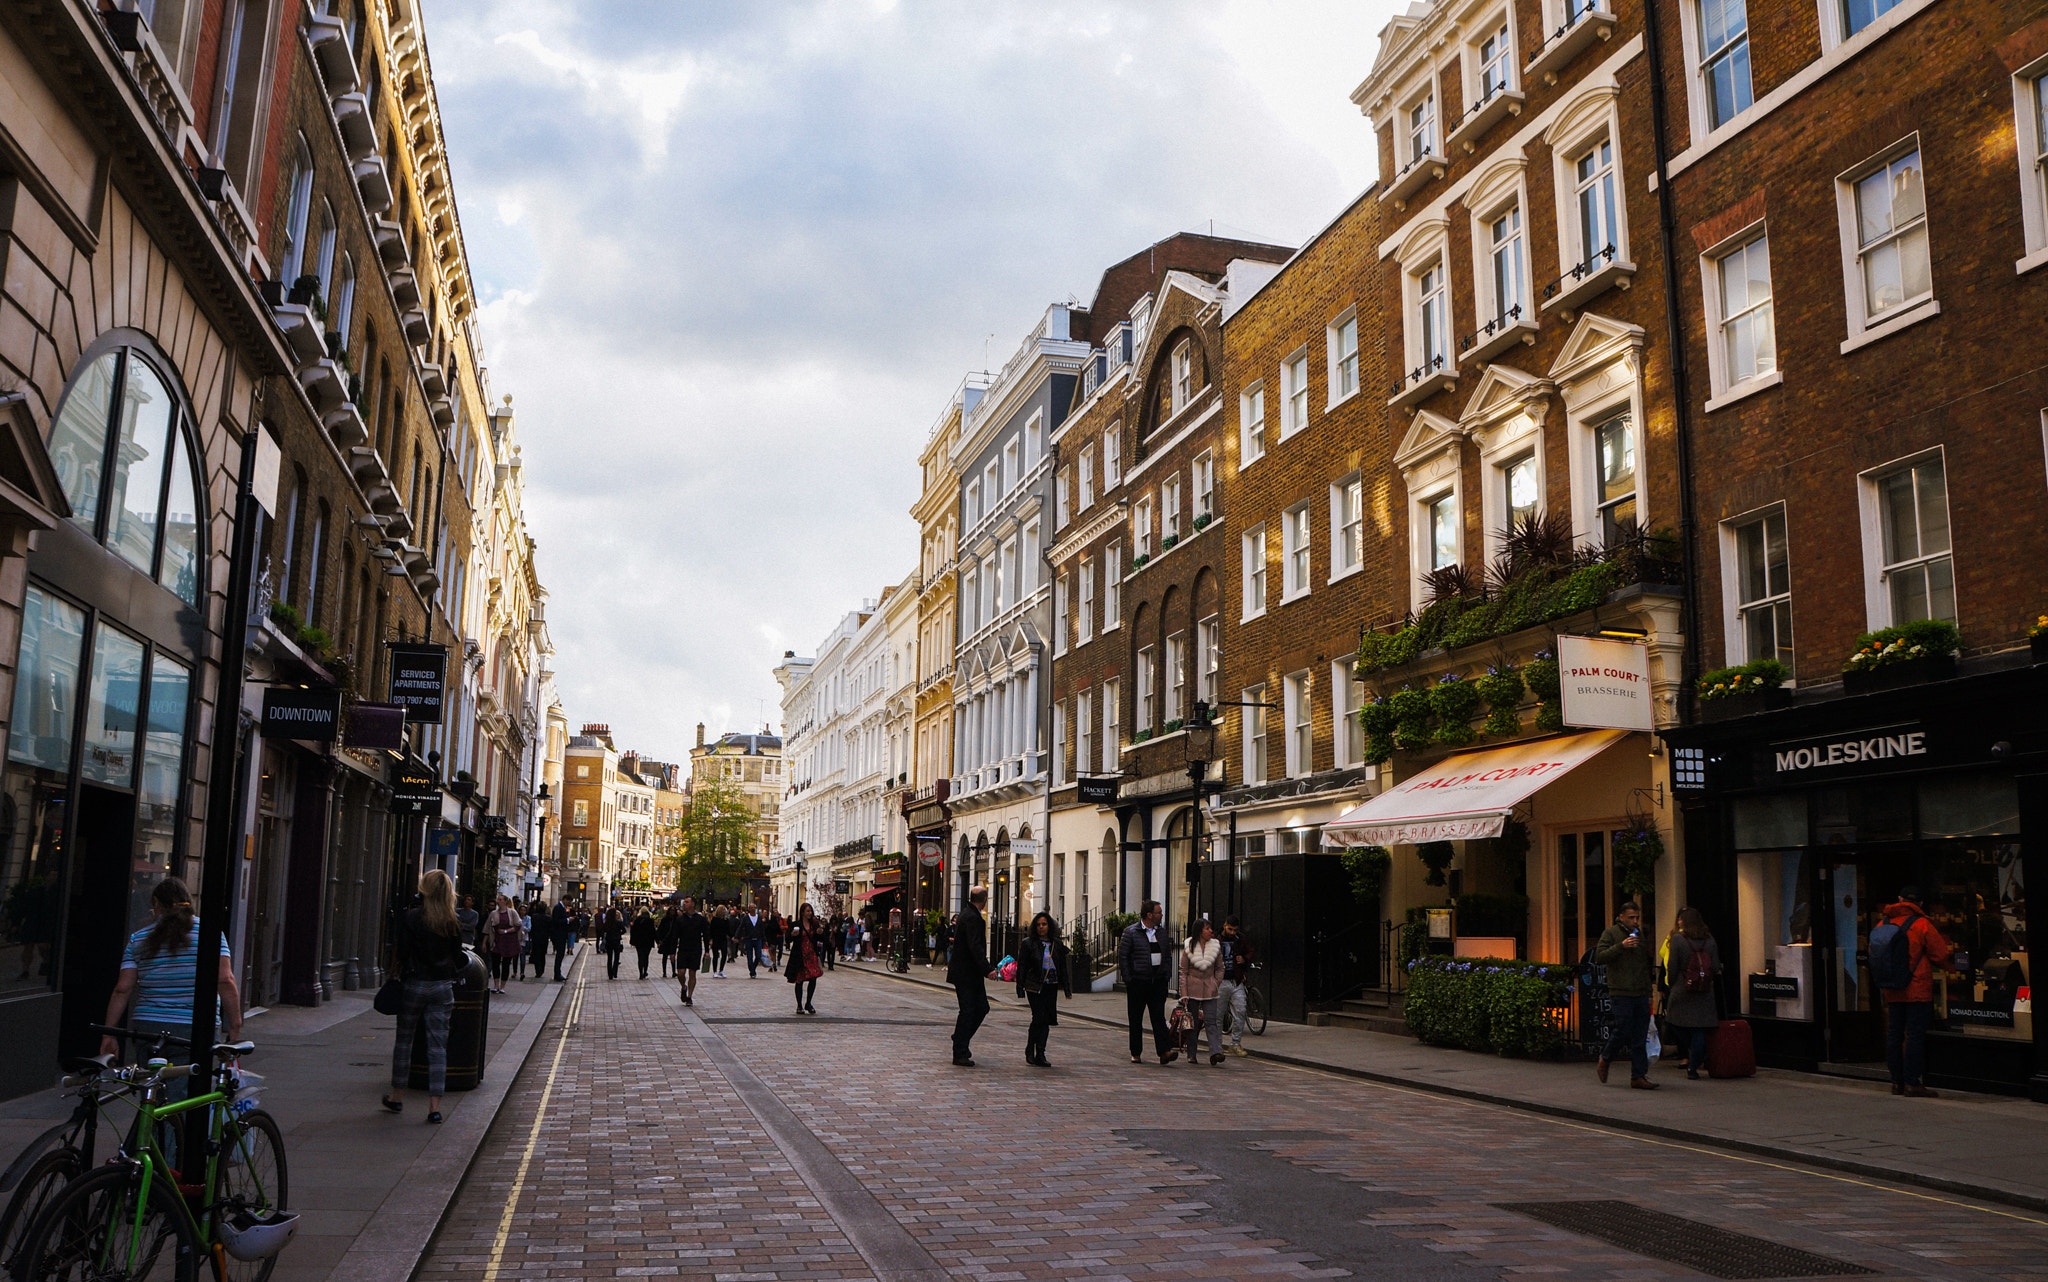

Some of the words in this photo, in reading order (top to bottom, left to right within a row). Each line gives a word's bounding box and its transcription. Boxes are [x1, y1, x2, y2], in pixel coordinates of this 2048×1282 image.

[400, 669, 436, 680] SERVICED
[1571, 667, 1600, 677] PALM
[1603, 668, 1640, 683] COURT
[393, 679, 441, 690] APARTMENTS
[1577, 686, 1637, 699] BRASSERIE
[393, 695, 406, 705] 020
[406, 695, 423, 706] 7907
[424, 696, 440, 706] 4501
[269, 706, 332, 723] DOWNTOWN
[1775, 732, 1927, 772] MOLESKINE
[1405, 772, 1482, 794] PALM
[1478, 762, 1564, 782] COURT
[1083, 786, 1112, 794] HACKETT
[478, 815, 506, 830] NARS
[1950, 1008, 1972, 1017] NOMAD
